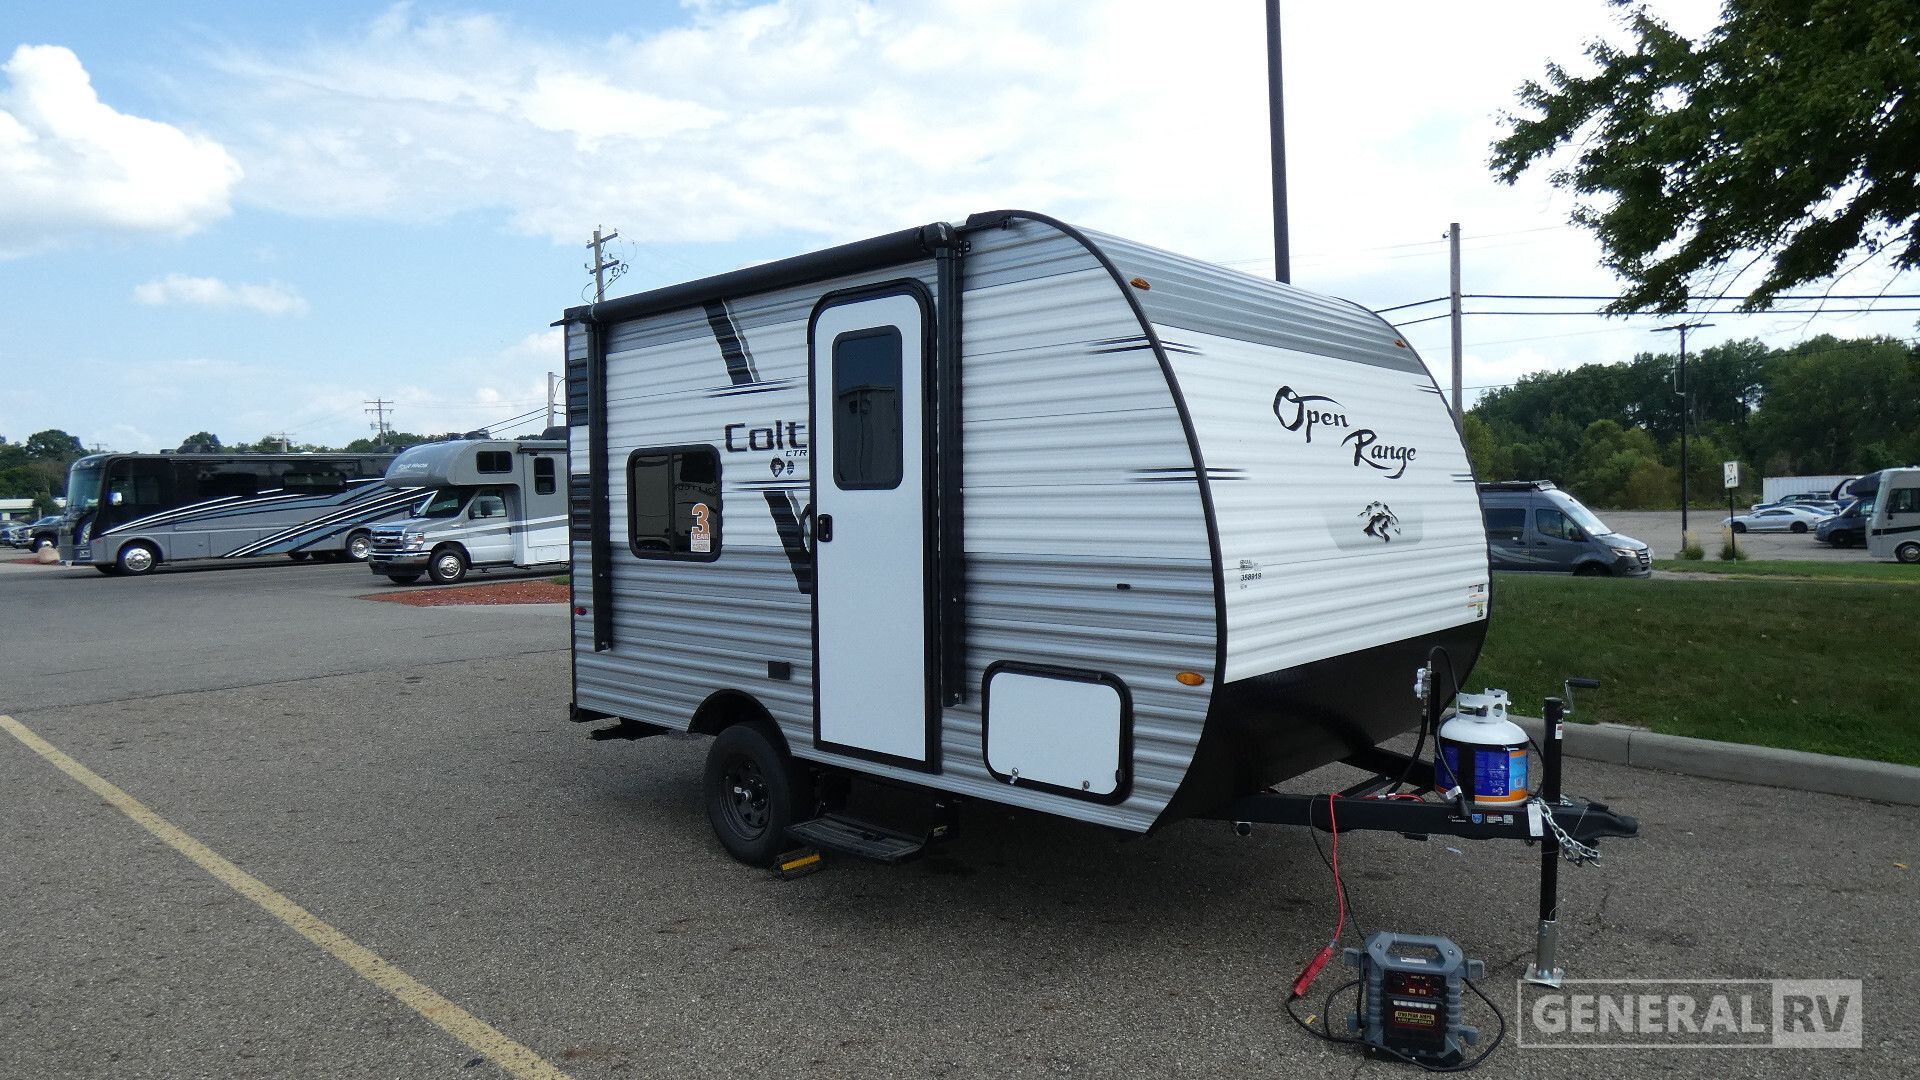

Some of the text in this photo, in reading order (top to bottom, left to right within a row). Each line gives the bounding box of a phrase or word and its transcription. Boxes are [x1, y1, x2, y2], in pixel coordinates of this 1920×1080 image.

[1272, 385, 1349, 443] Open
[724, 420, 807, 452] Colt
[1341, 429, 1417, 480] Range
[691, 503, 709, 533] 3
